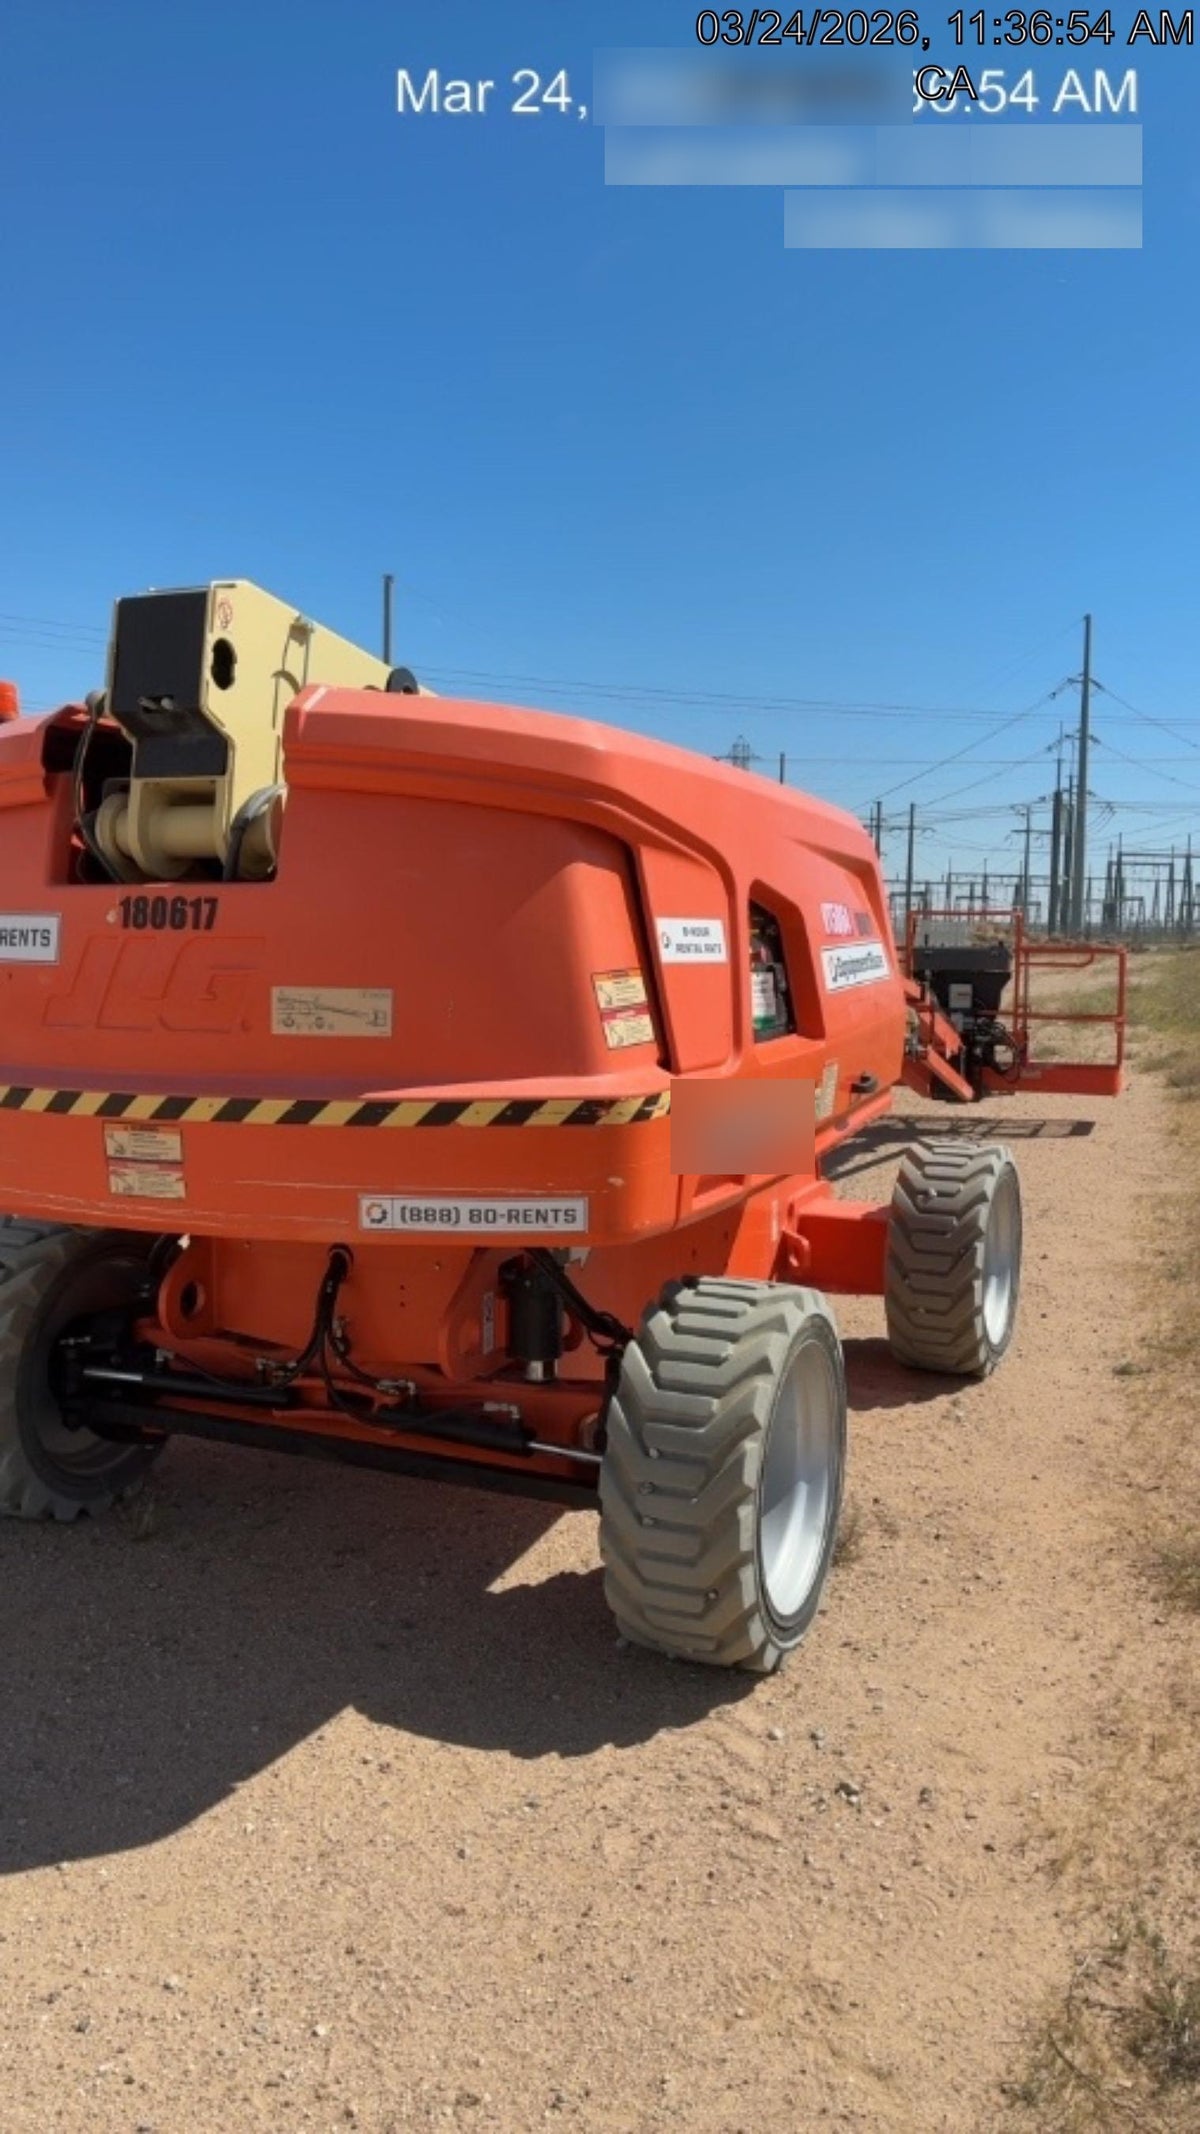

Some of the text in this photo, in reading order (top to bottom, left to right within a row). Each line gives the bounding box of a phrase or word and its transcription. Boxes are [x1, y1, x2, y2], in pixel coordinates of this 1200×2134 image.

[119, 896, 219, 930] 180617
[400, 1206, 578, 1225] (888) 80-RENTS
